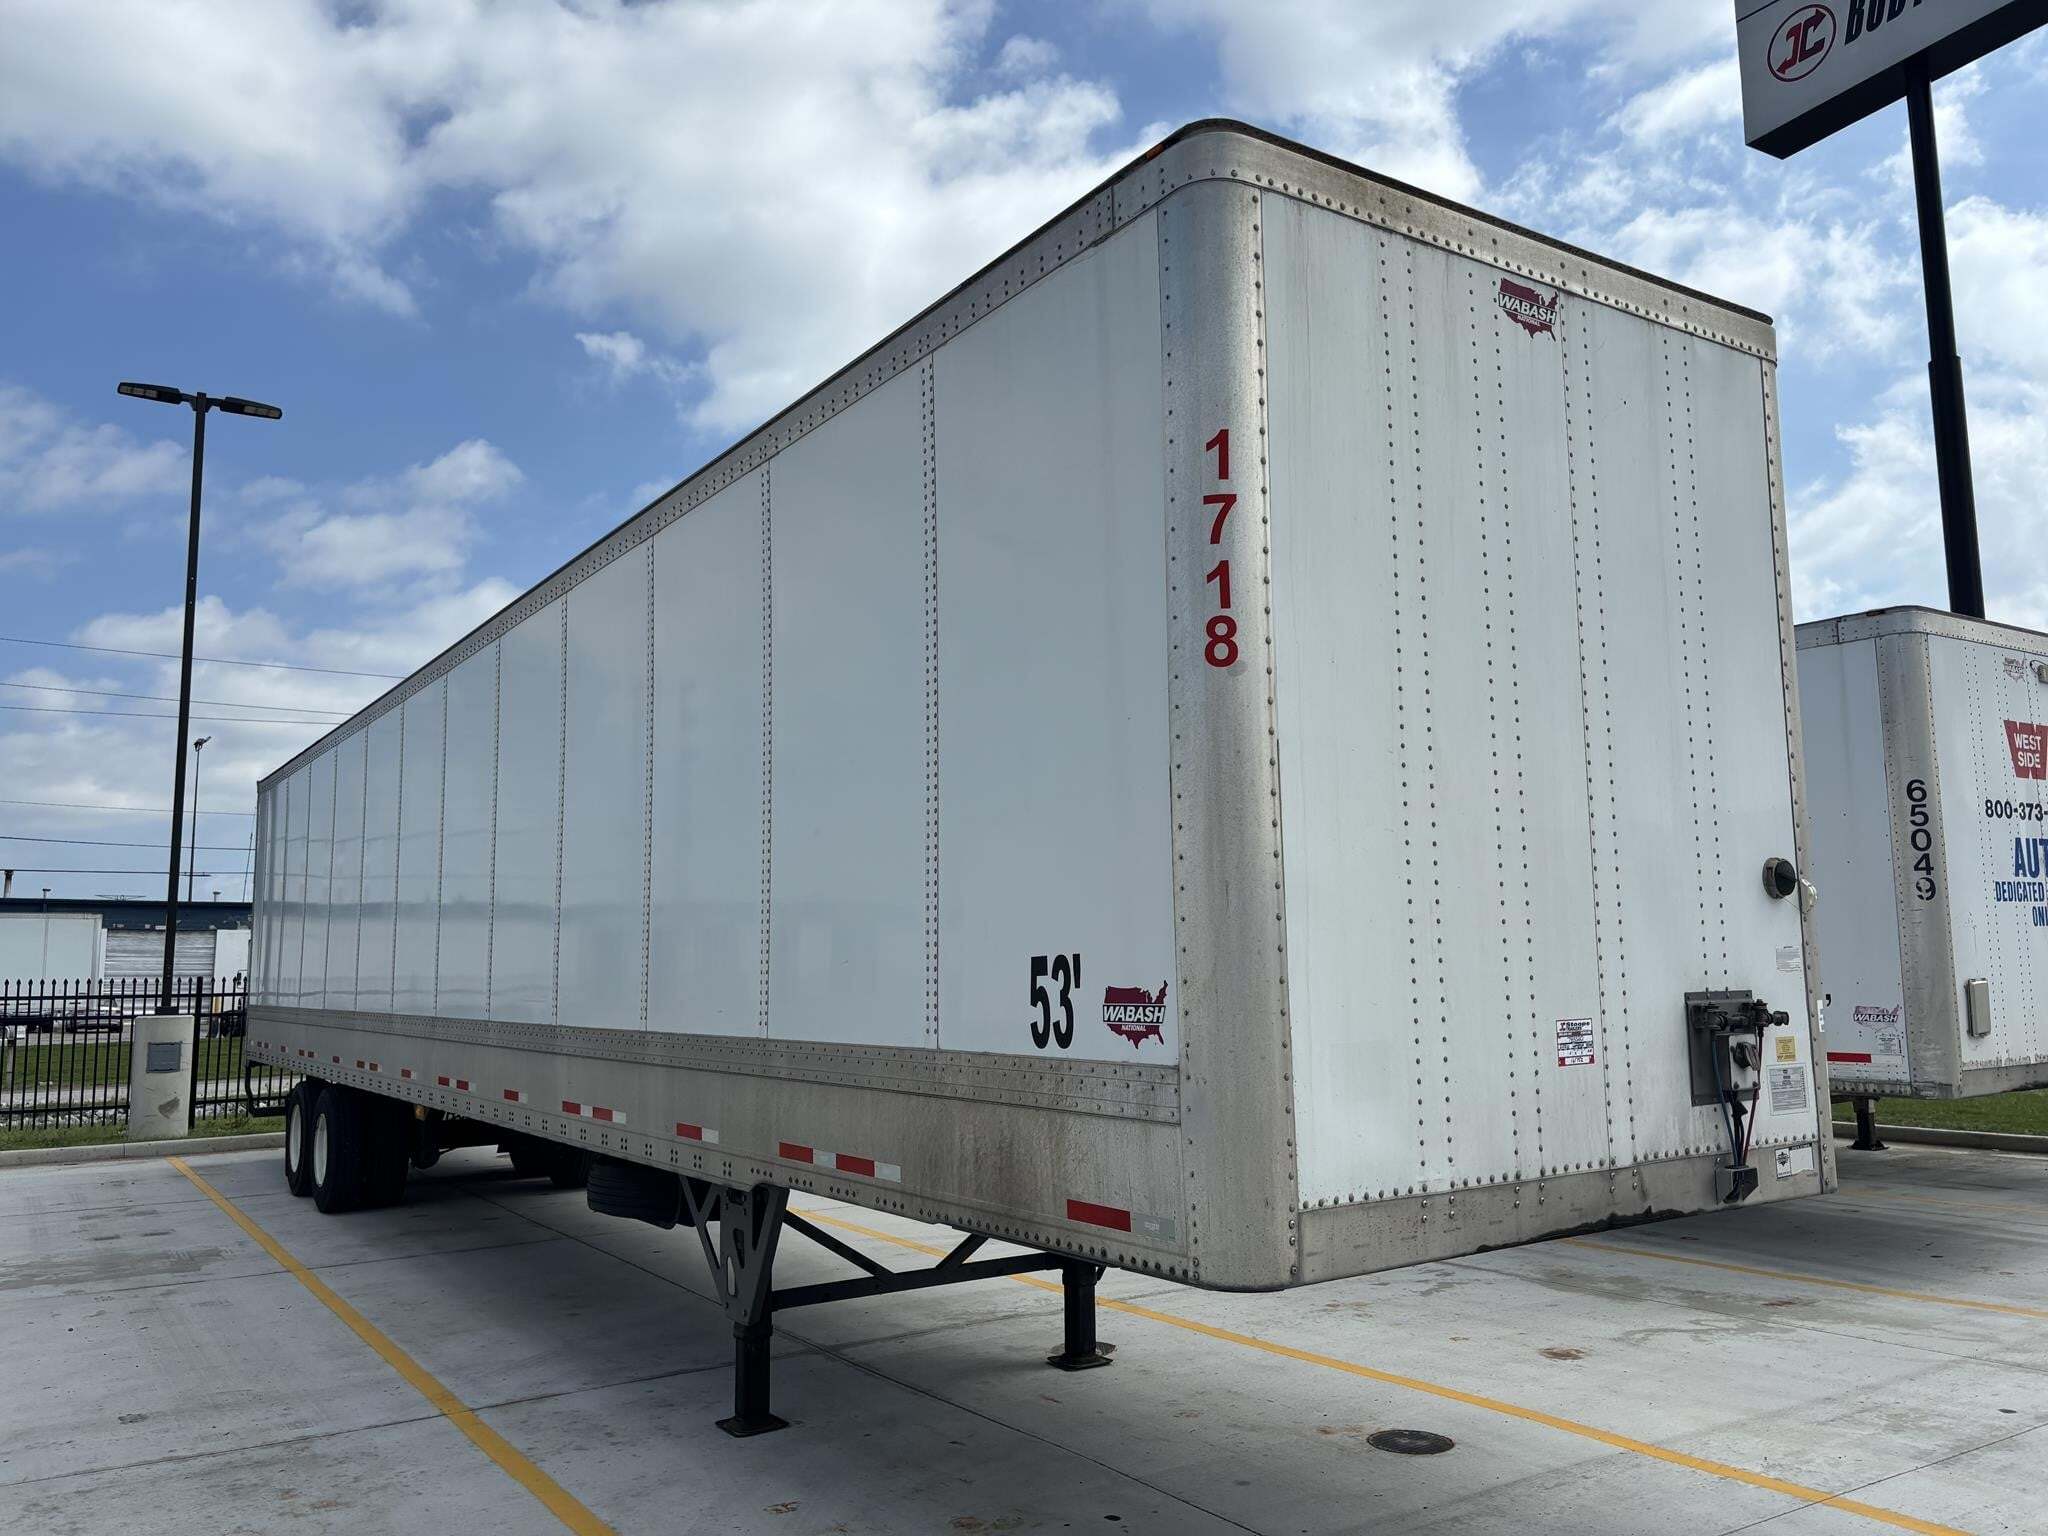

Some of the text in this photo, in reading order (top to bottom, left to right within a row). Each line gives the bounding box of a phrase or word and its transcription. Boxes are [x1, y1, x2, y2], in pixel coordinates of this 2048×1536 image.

[1844, 0, 1922, 45] BO
[1499, 293, 1556, 324] WABASH
[1203, 428, 1239, 668] 1718
[2013, 732, 2042, 751] WEST
[2017, 752, 2041, 768] SIDE
[1985, 799, 2048, 821] 800-373-
[1906, 778, 1937, 901] 65049
[1995, 881, 2045, 902] DEDICATED
[1030, 953, 1080, 1049] 53'
[1104, 1005, 1164, 1023] WABASH
[1854, 1013, 1898, 1022] WABASH
[1121, 1024, 1147, 1032] NATIONAL
